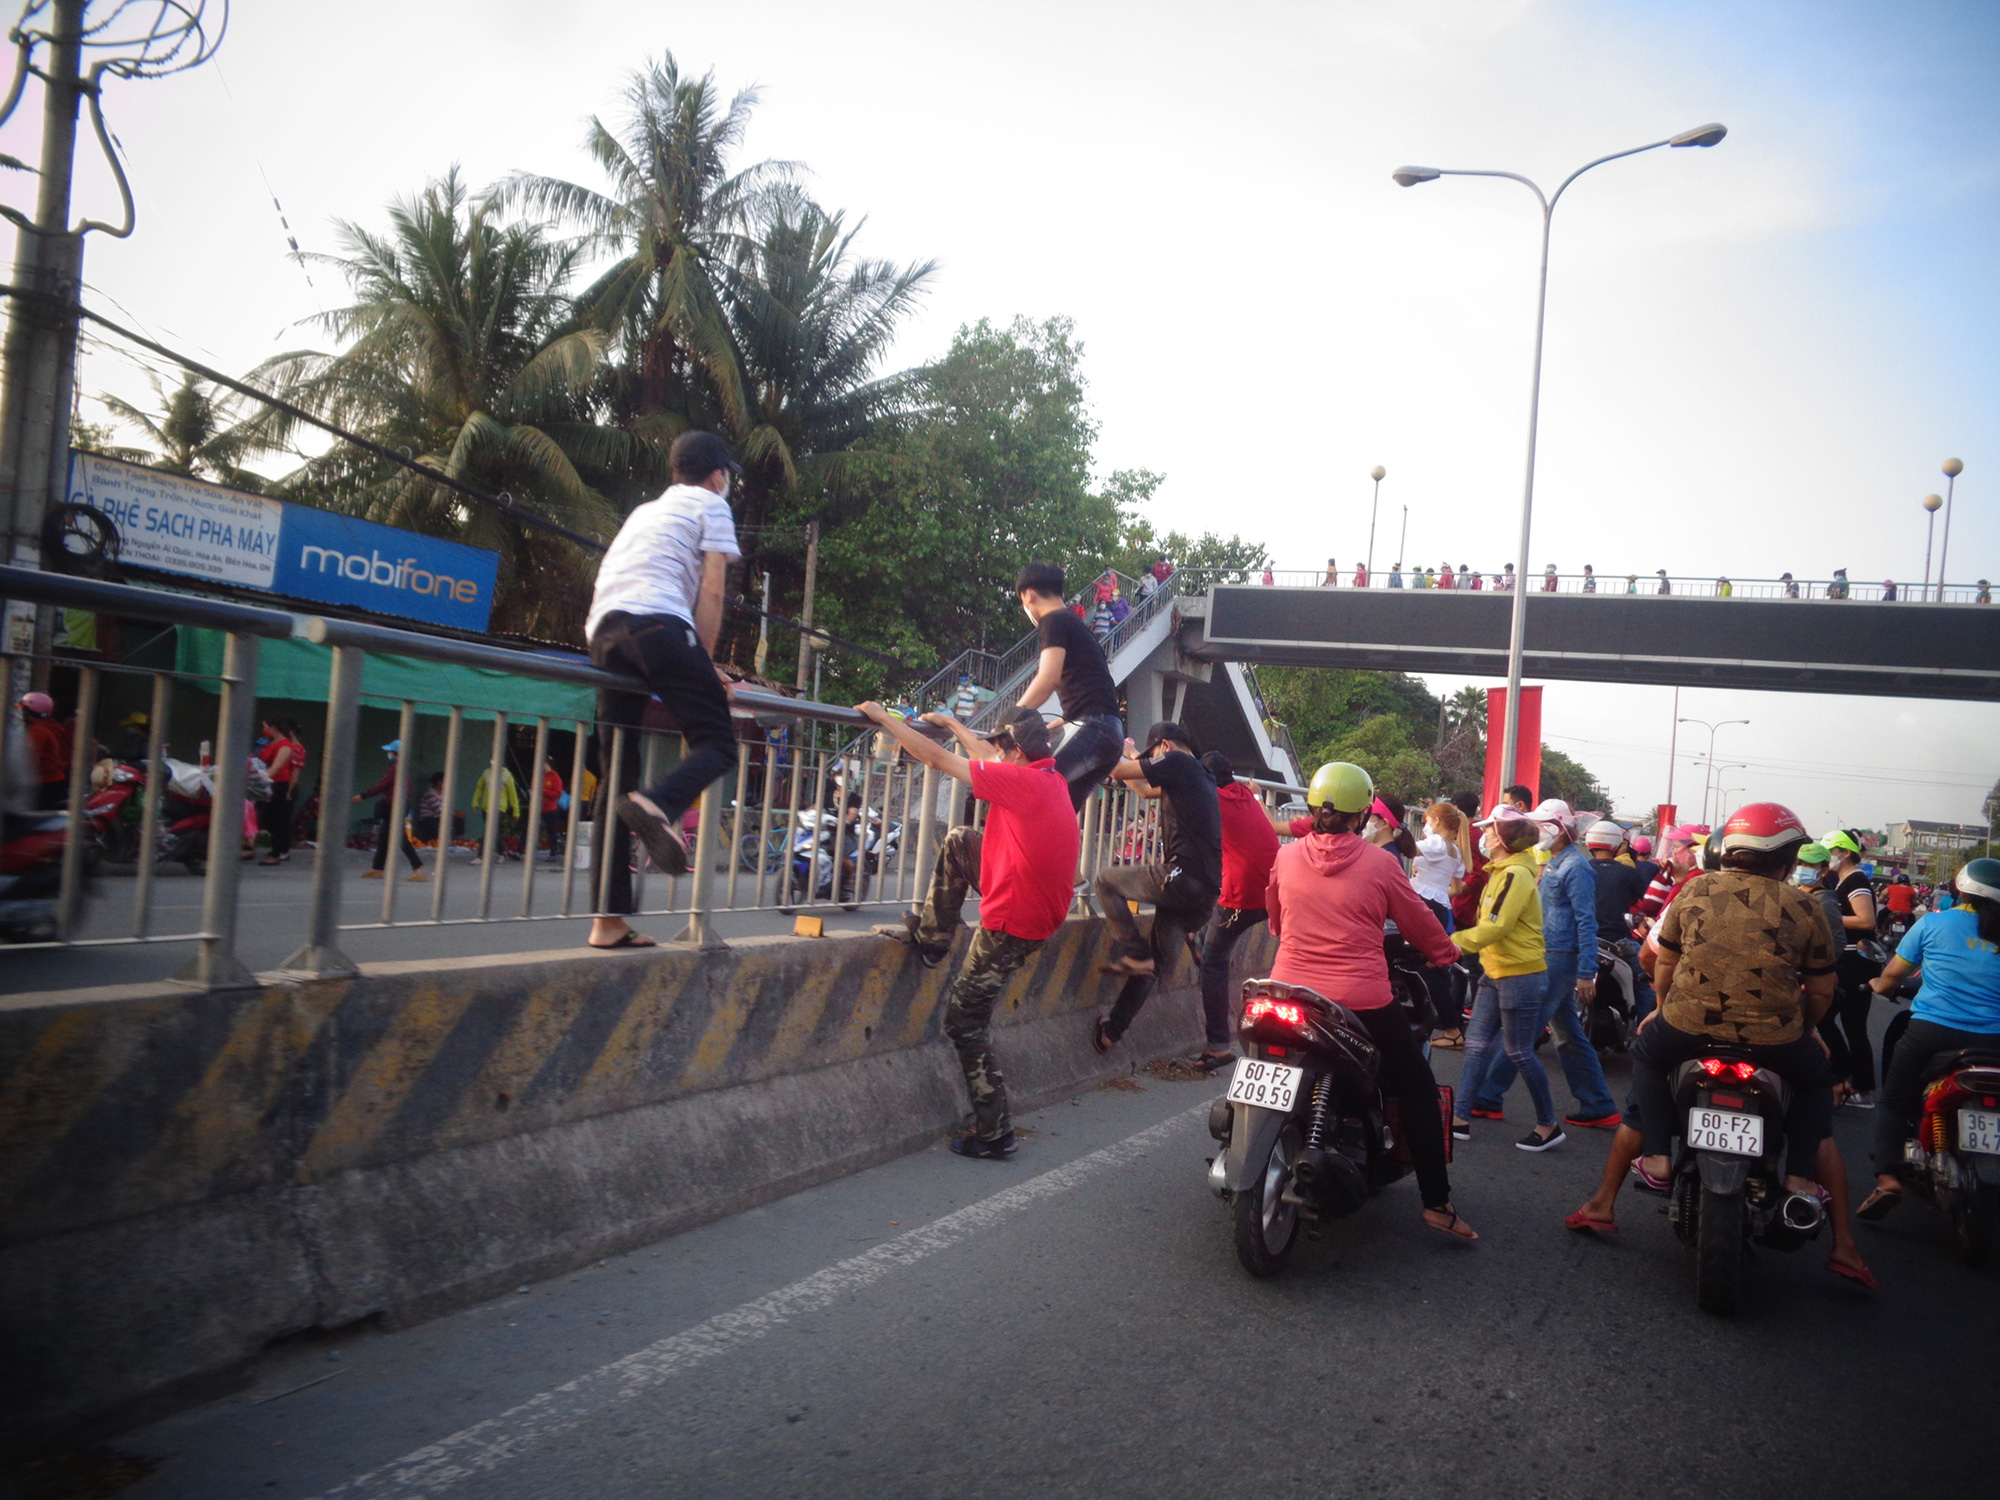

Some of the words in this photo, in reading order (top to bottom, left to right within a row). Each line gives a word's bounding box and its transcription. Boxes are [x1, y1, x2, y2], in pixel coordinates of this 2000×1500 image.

[102, 497, 140, 528] PHÊ
[145, 507, 195, 539] SẠCH
[198, 518, 233, 549] PHA
[237, 525, 276, 556] MÁY
[300, 544, 478, 604] mobifone
[1245, 1062, 1291, 1087] 60-F2
[1233, 1080, 1292, 1107] 209.59
[1701, 1112, 1751, 1134] 60-F2
[1968, 1114, 2000, 1134] 36-
[1693, 1129, 1758, 1153] 706.12
